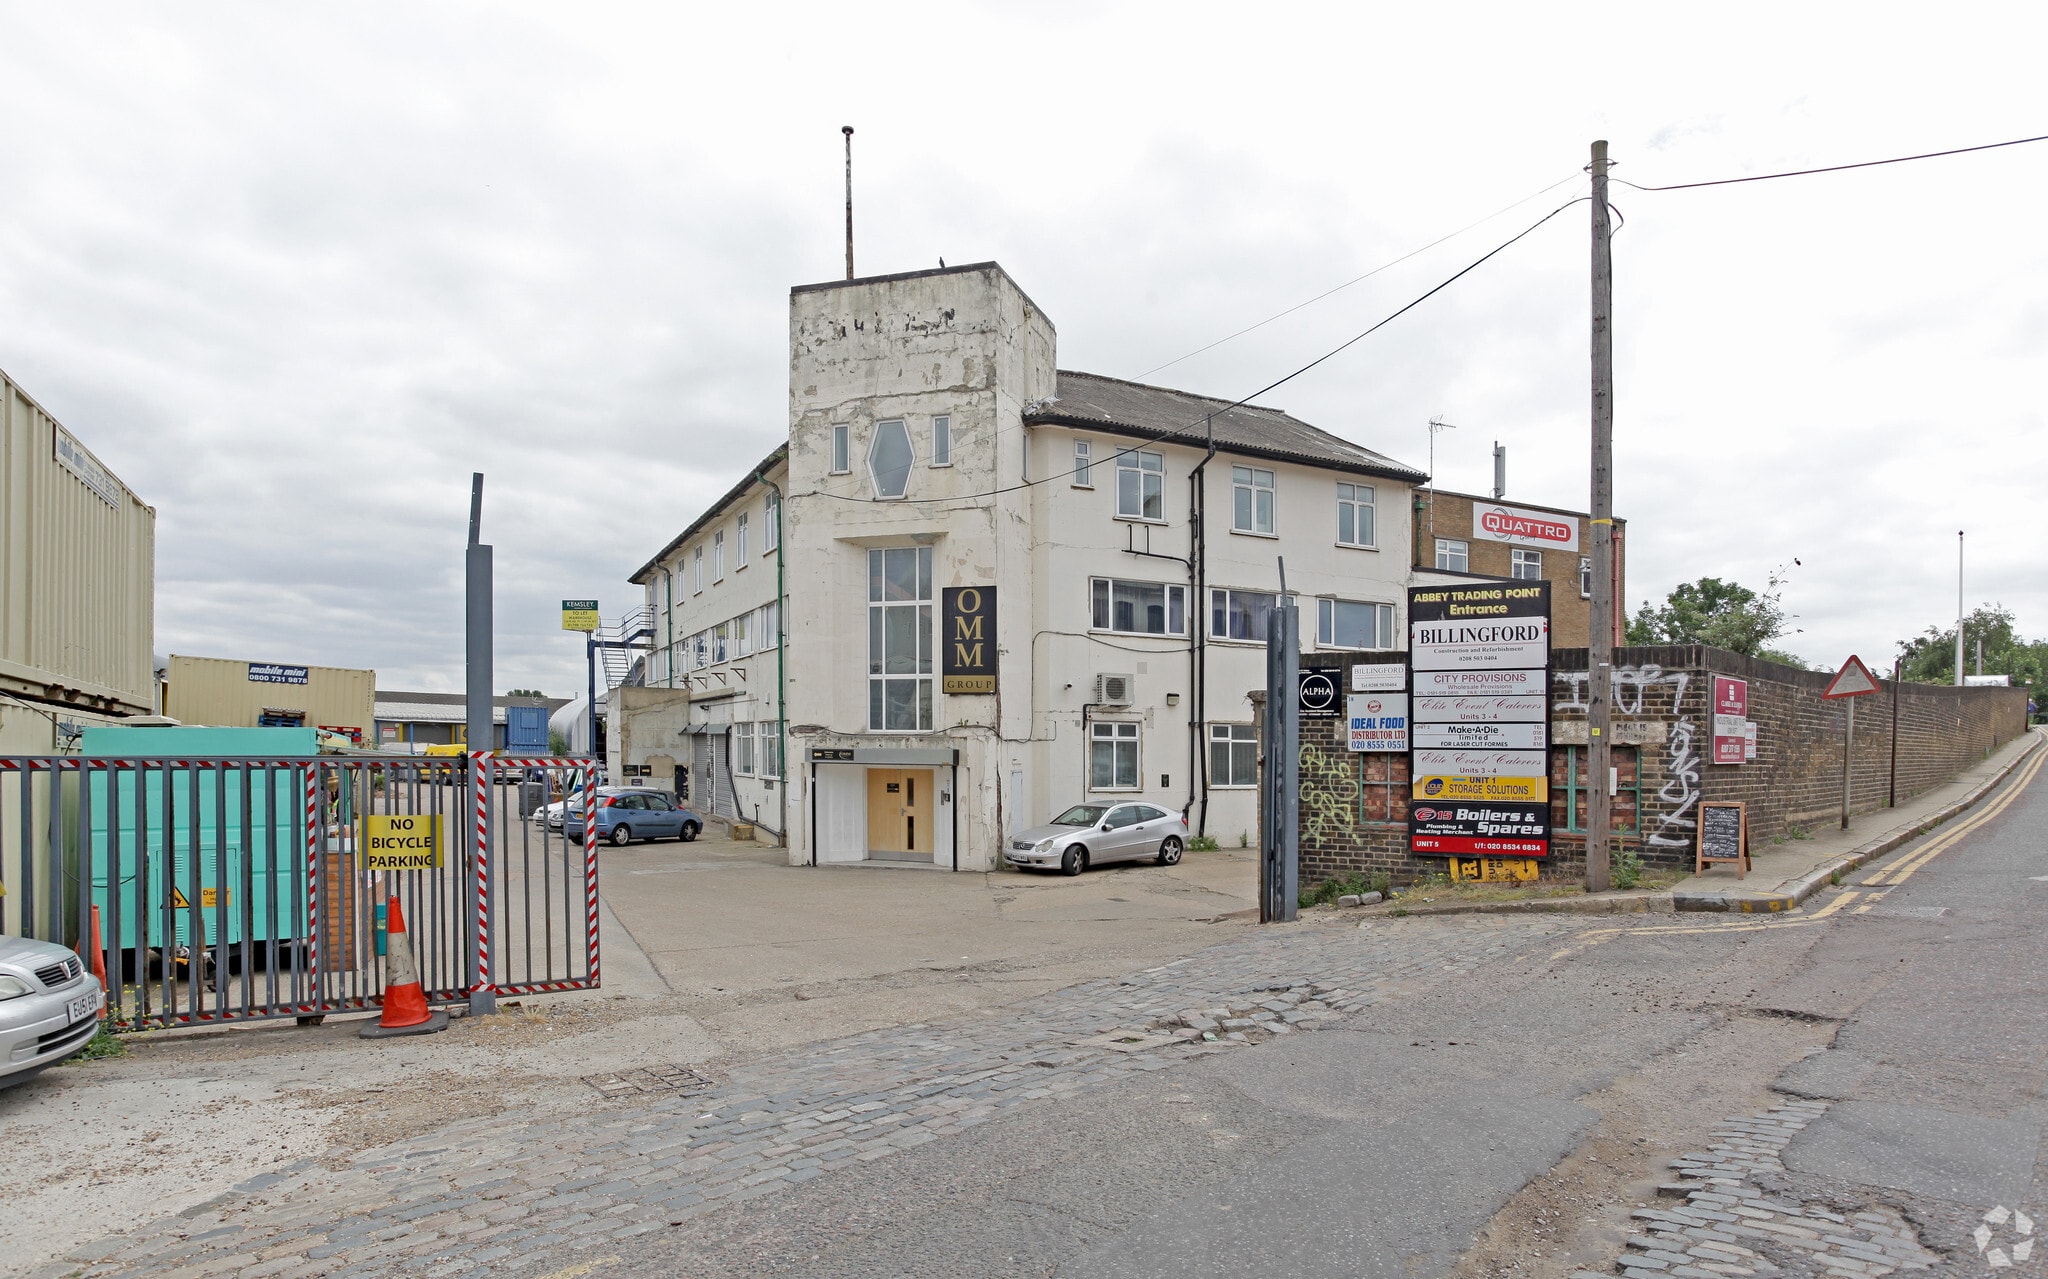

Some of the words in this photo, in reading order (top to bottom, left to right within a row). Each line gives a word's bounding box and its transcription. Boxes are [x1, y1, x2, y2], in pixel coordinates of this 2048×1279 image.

[1486, 514, 1567, 538] QUATTRO
[1414, 592, 1449, 603] ABBEY
[1451, 590, 1502, 601] TRADING
[1506, 588, 1541, 599] POINT
[1450, 604, 1508, 616] Entrance
[1420, 626, 1540, 644] BILLINGFORD
[250, 666, 283, 675] mobile
[947, 680, 992, 688] GROUP
[1434, 674, 1458, 684] CITY
[1461, 673, 1527, 684] PROVISIONS
[1419, 698, 1446, 710] Elite
[1452, 698, 1489, 710] Event
[1492, 698, 1542, 710] Caterers
[1351, 718, 1377, 729] IDEAL
[1380, 717, 1404, 729] FOOD
[1352, 731, 1392, 740] DISTRIBUTOR
[1394, 730, 1405, 739] LTD
[1388, 740, 1405, 748] 0551
[1419, 752, 1446, 764] Elite
[1452, 752, 1489, 764] Event
[1492, 753, 1541, 765] Caterers
[1470, 776, 1490, 784] UNIT
[1449, 784, 1482, 794] STORAGE
[1487, 785, 1529, 795] SOLUTIONS
[1456, 808, 1521, 822] Boilers
[1524, 813, 1535, 822] &
[390, 819, 414, 830] NO
[1477, 822, 1544, 836] Spares
[372, 837, 431, 848] BICYCLE
